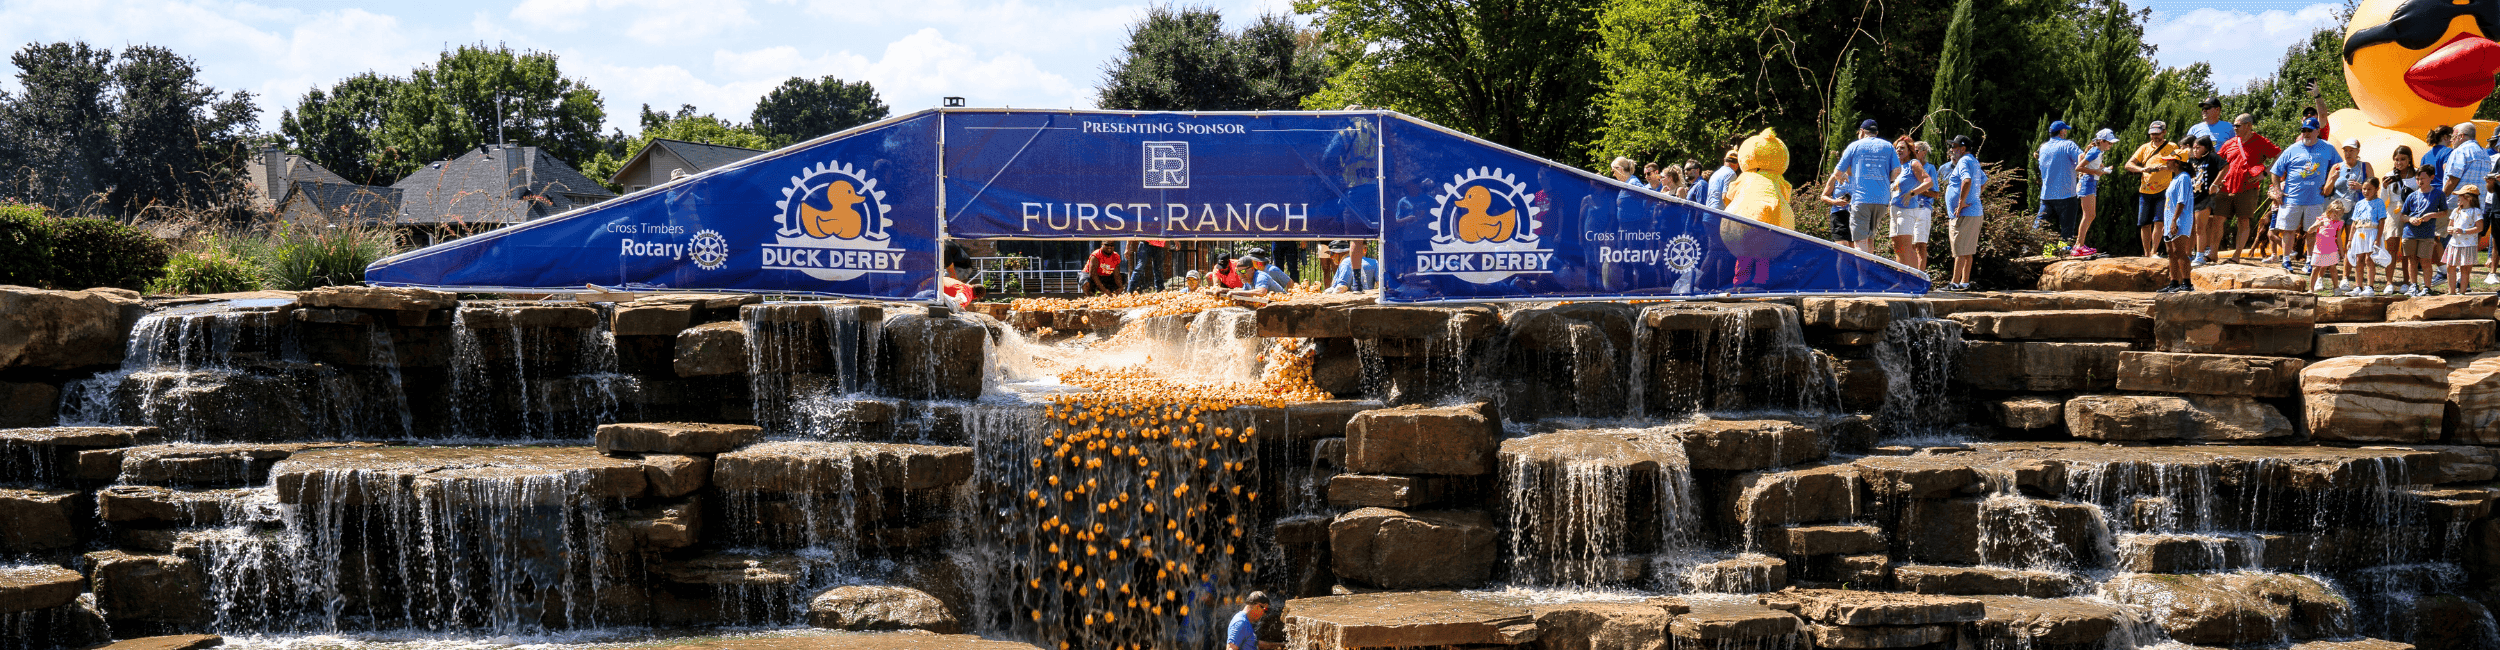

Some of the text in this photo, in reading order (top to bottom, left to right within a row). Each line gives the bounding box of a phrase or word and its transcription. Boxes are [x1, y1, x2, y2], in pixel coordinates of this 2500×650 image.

[606, 222, 685, 234] Cross Timbers
[1584, 229, 1661, 241] Cross Timbers
[621, 238, 684, 260] Rotary
[762, 248, 905, 270] DUCK DERBY
[1599, 246, 1660, 266] Rotary
[1417, 253, 1554, 273] DUCK DERBY
